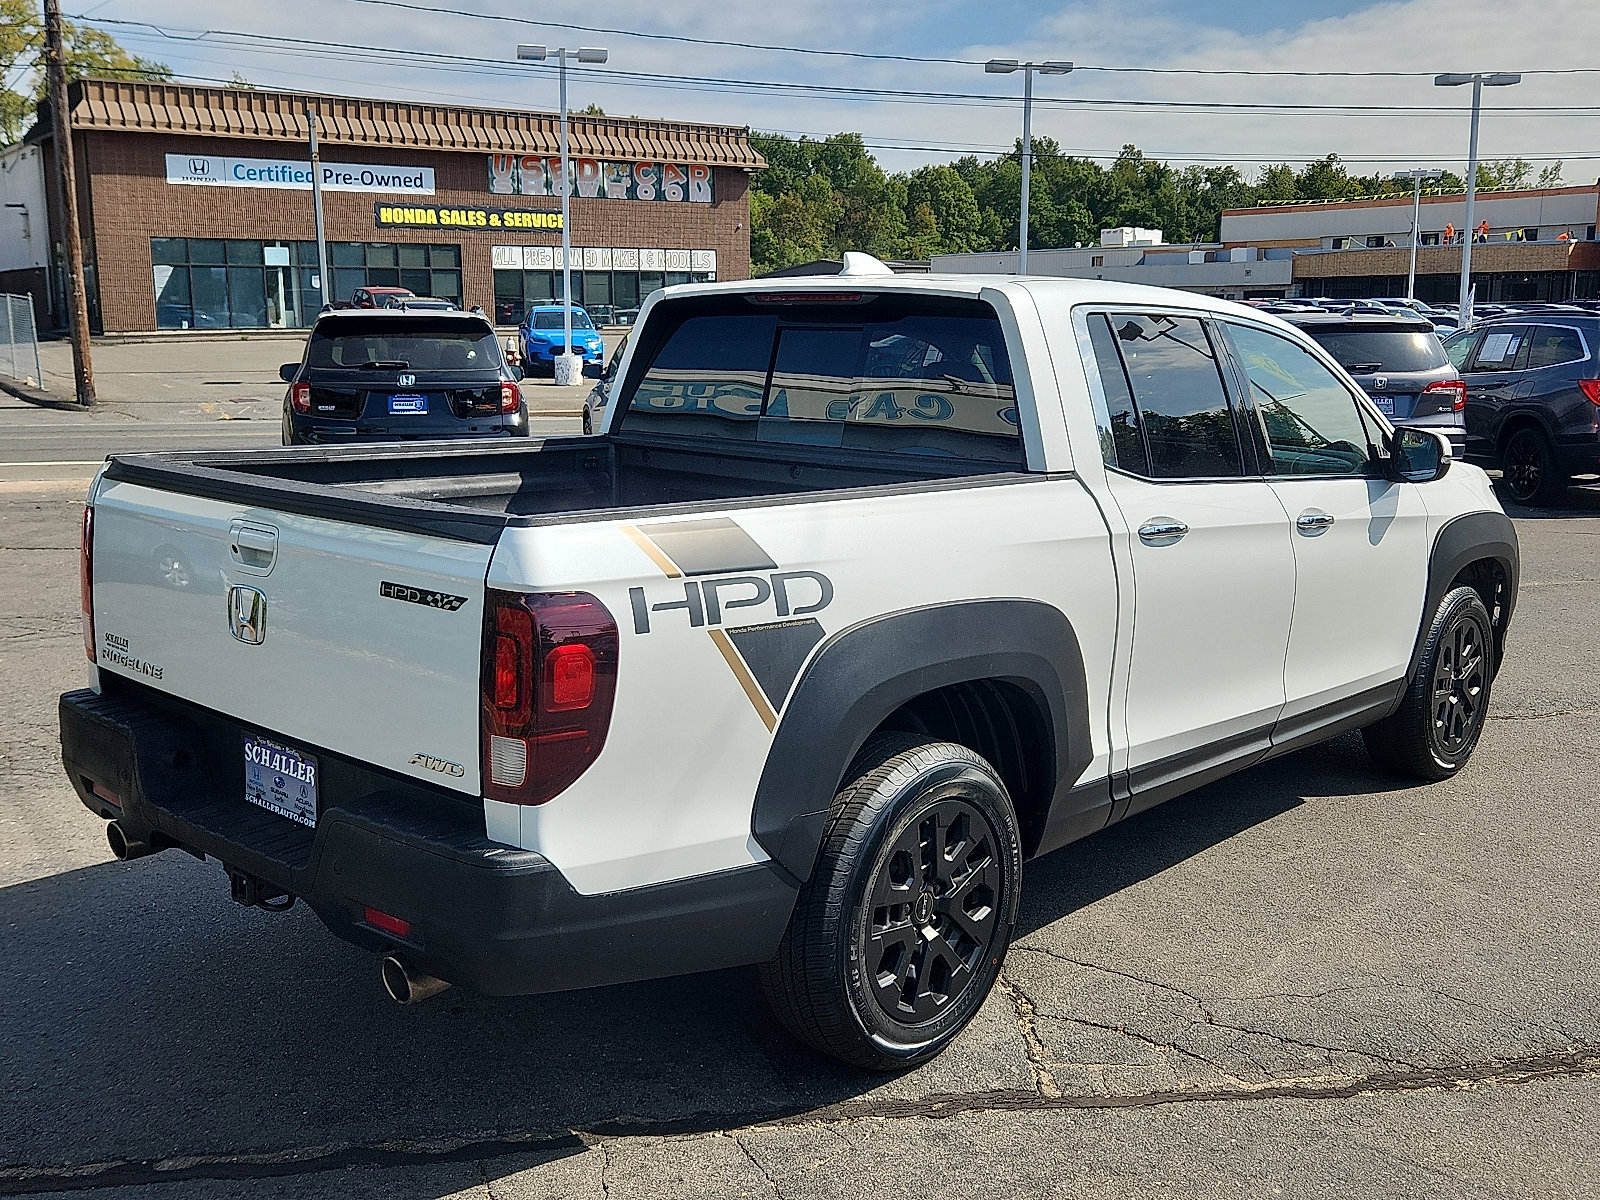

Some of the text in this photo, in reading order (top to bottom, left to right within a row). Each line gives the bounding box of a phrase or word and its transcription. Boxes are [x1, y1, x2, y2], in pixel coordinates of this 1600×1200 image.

[323, 169, 424, 188] Pre-Owned
[492, 154, 708, 190] USED CAR
[493, 178, 711, 202] SHOWROOM
[380, 207, 563, 228] HONDA SALES & SERVICE
[494, 248, 516, 265] ALL
[602, 250, 643, 267] MAKES
[647, 251, 654, 267] &
[658, 251, 710, 268] MODELS
[381, 583, 420, 602] HPD
[628, 571, 834, 634] HPD
[747, 623, 781, 632] Performance
[782, 619, 816, 628] Development
[103, 647, 163, 679] RIDGELINE
[245, 742, 315, 787] SCHALLER
[408, 752, 465, 778] AWD
[245, 793, 316, 829] SCHALLERAUTO.COM
